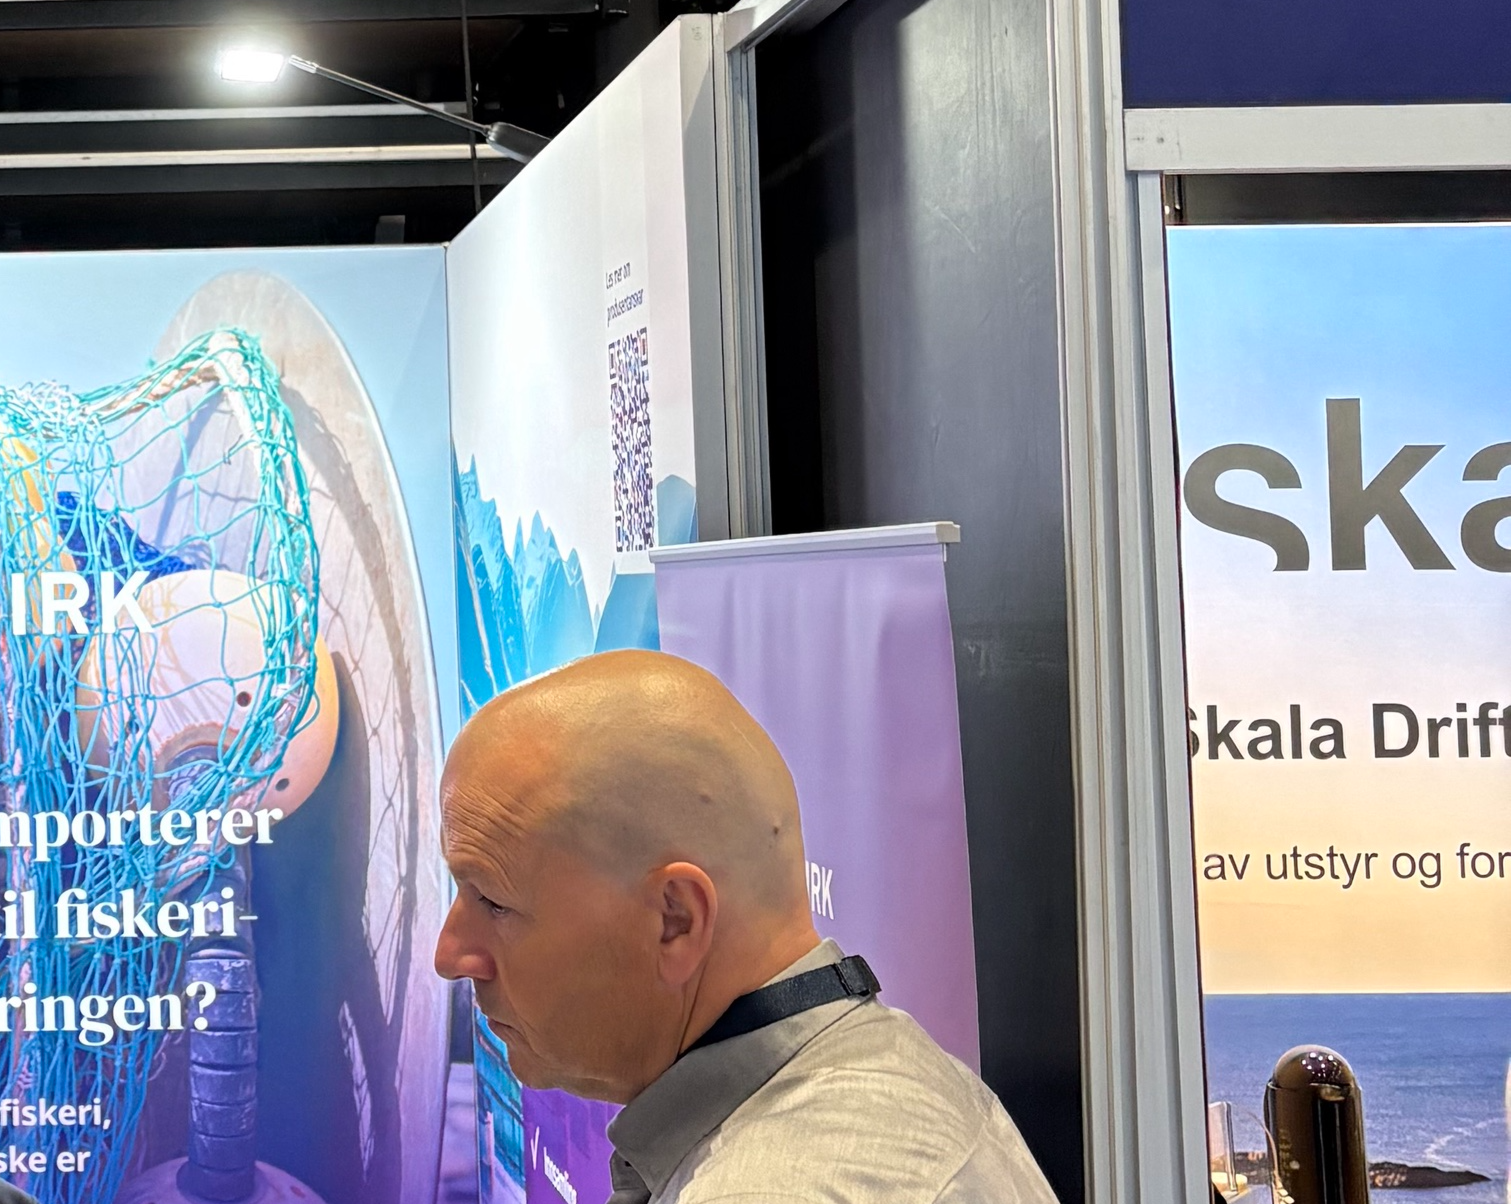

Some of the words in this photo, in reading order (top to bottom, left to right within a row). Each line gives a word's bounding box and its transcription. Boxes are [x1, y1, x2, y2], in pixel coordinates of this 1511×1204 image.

[1203, 853, 1250, 881] av
[1266, 845, 1378, 889] utstyr
[1392, 852, 1442, 889] og
[53, 887, 258, 940] fiskeri-
[56, 1149, 92, 1173] er
